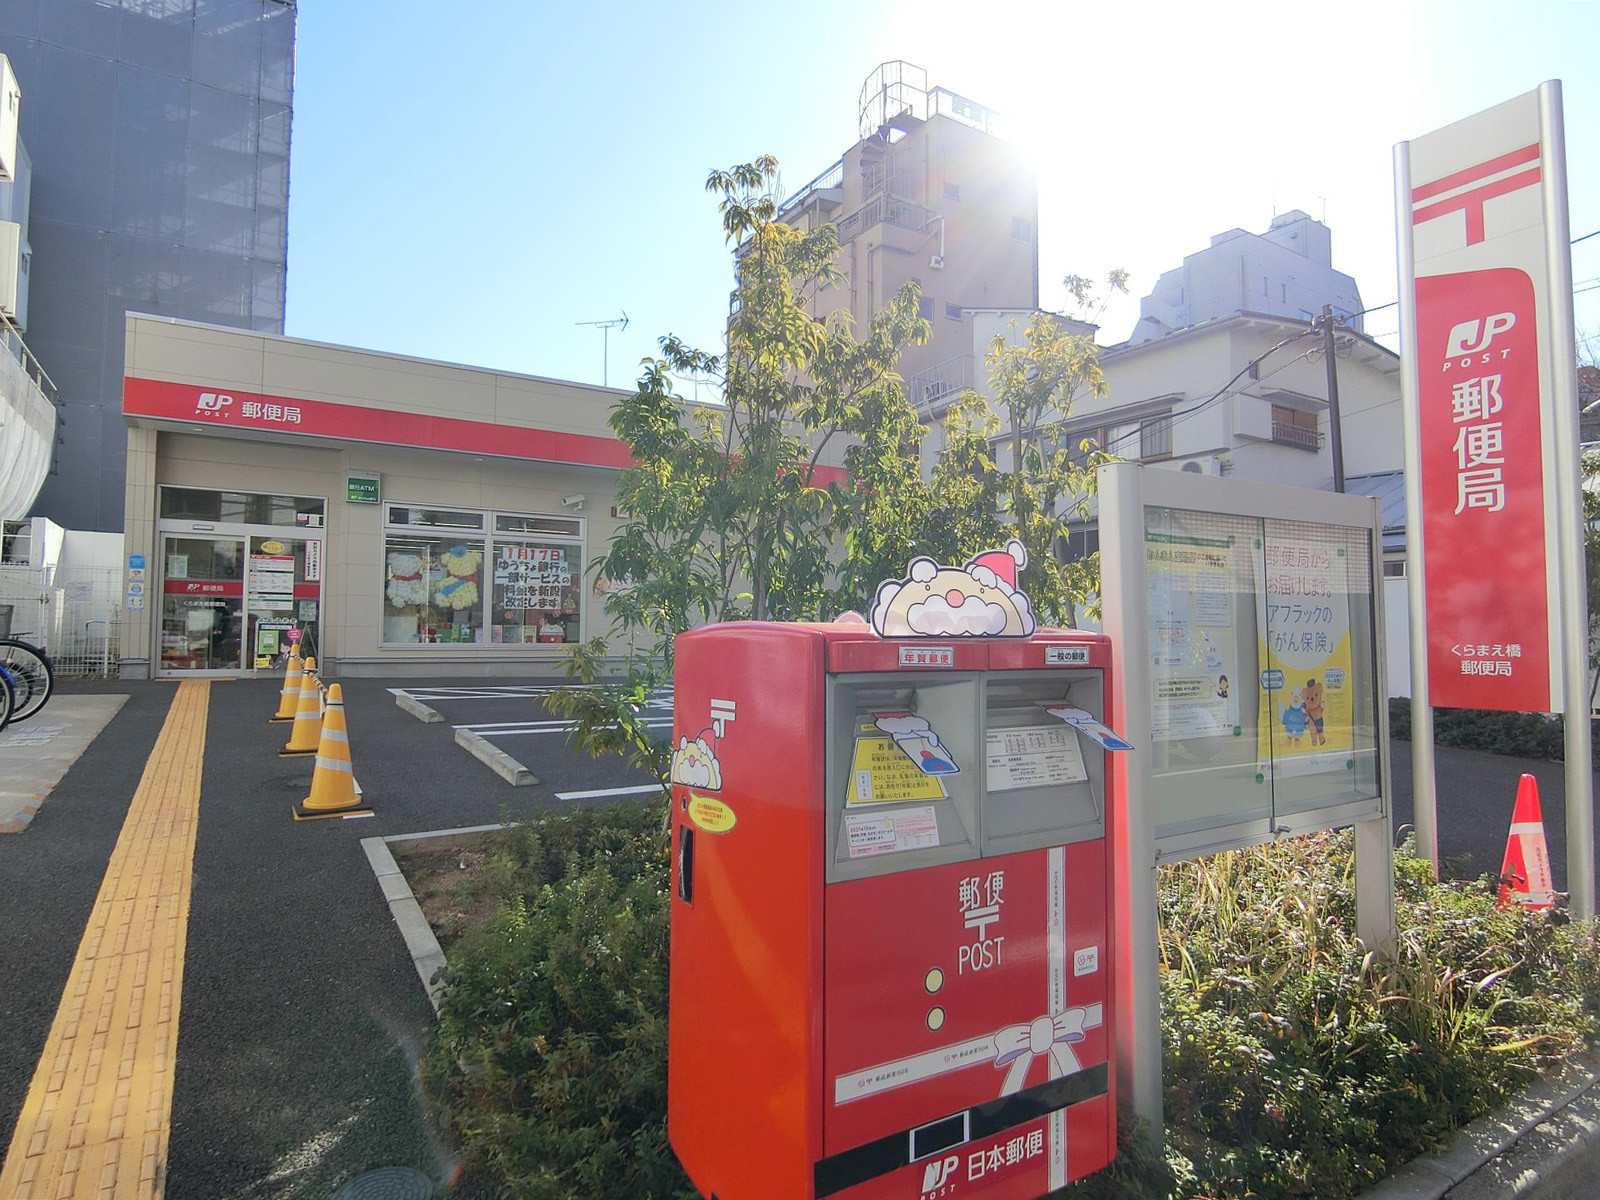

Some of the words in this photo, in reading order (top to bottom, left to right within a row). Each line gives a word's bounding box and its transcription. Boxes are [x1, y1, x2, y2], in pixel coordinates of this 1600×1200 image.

[1445, 311, 1516, 359] JP
[1442, 348, 1511, 372] POST
[195, 409, 230, 419] POST
[241, 401, 302, 424] 郵便局
[1451, 373, 1505, 516] 郵便局
[508, 547, 561, 561] 1月17日
[1265, 545, 1331, 570] 郵便局から
[498, 560, 568, 573] ゆうちょ銀行の
[496, 572, 570, 584] 一部サービスの
[1267, 574, 1332, 598] お届けします。
[504, 584, 561, 597] 料金を新設
[1268, 604, 1333, 624] アフラックの
[1268, 630, 1334, 654] 「がん保険」
[1451, 643, 1521, 658] くらまえ橋
[904, 652, 949, 664] 年賀郵便
[1050, 652, 1085, 661] 一般の郵便
[1460, 660, 1512, 677] 郵便局
[959, 870, 1004, 912] 郵便
[958, 936, 1005, 975] POST
[968, 1129, 1043, 1181] 日本郵便
